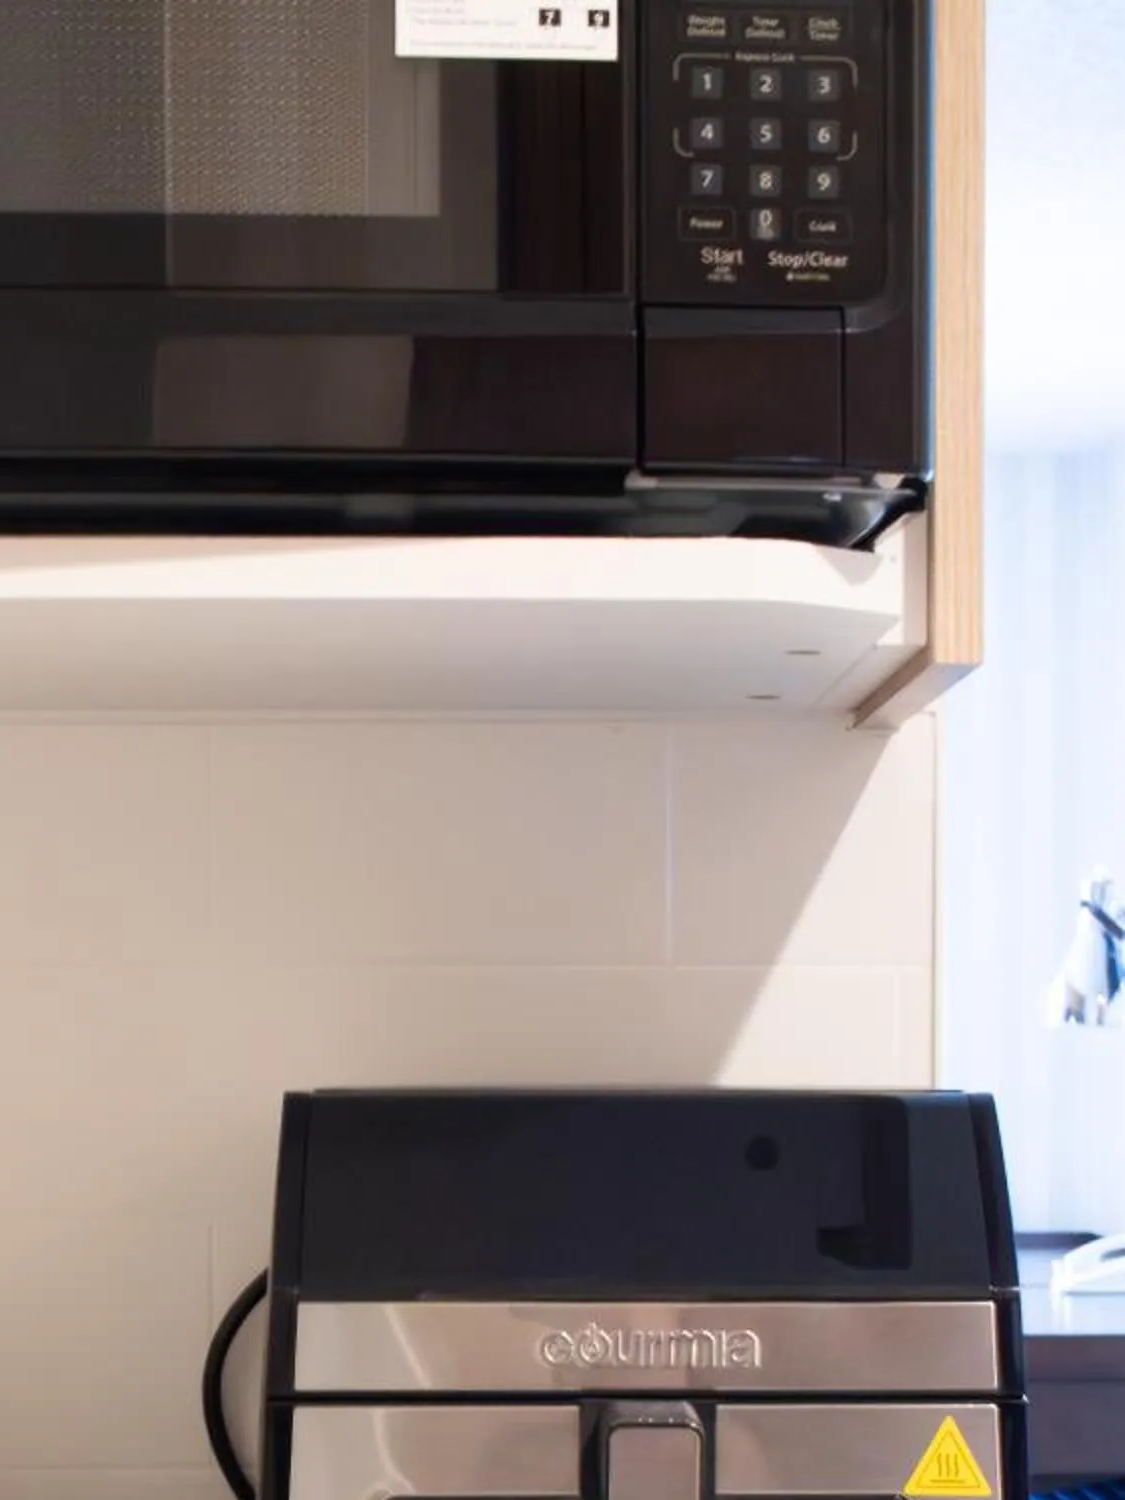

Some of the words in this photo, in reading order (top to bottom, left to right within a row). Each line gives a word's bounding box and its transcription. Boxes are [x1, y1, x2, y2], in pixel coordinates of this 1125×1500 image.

[703, 73, 712, 91] 1
[760, 76, 772, 93] 2
[819, 76, 830, 94] 3
[701, 124, 713, 140] 4
[760, 125, 772, 143] 5
[817, 127, 830, 144] 6
[701, 170, 714, 187] 7
[759, 172, 772, 189] 8
[817, 173, 830, 190] 9
[759, 208, 773, 227] 0
[700, 247, 744, 265] Start
[767, 250, 848, 268] Stop/Clear
